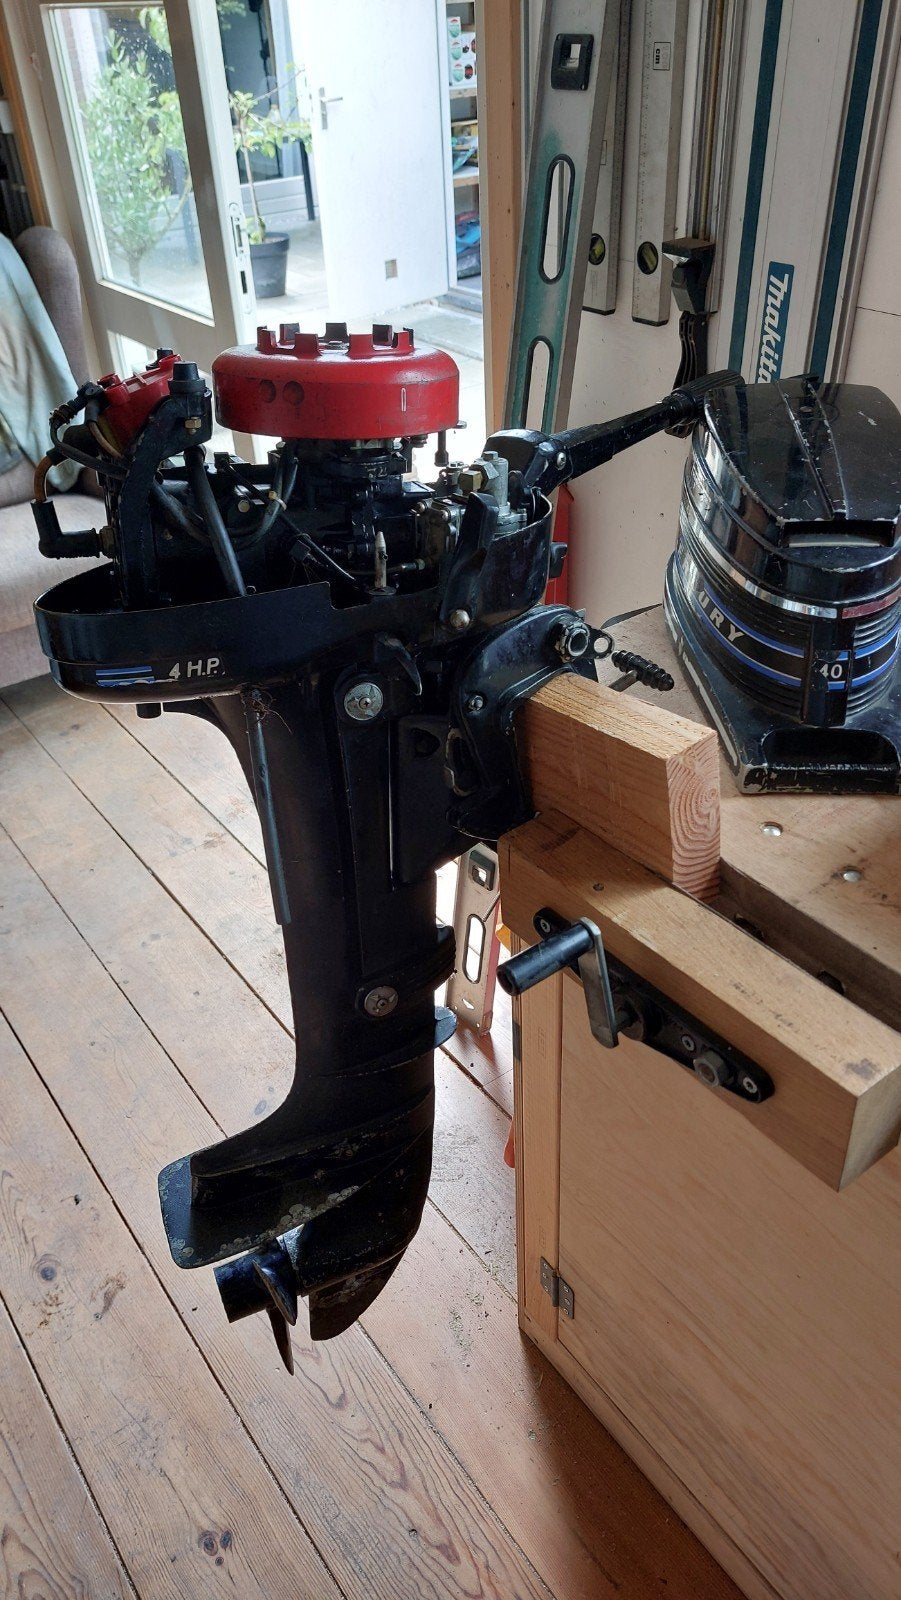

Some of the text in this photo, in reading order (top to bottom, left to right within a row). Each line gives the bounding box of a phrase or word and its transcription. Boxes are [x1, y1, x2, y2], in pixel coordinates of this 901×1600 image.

[757, 273, 790, 384] Makita
[168, 657, 220, 680] 4 H.P.
